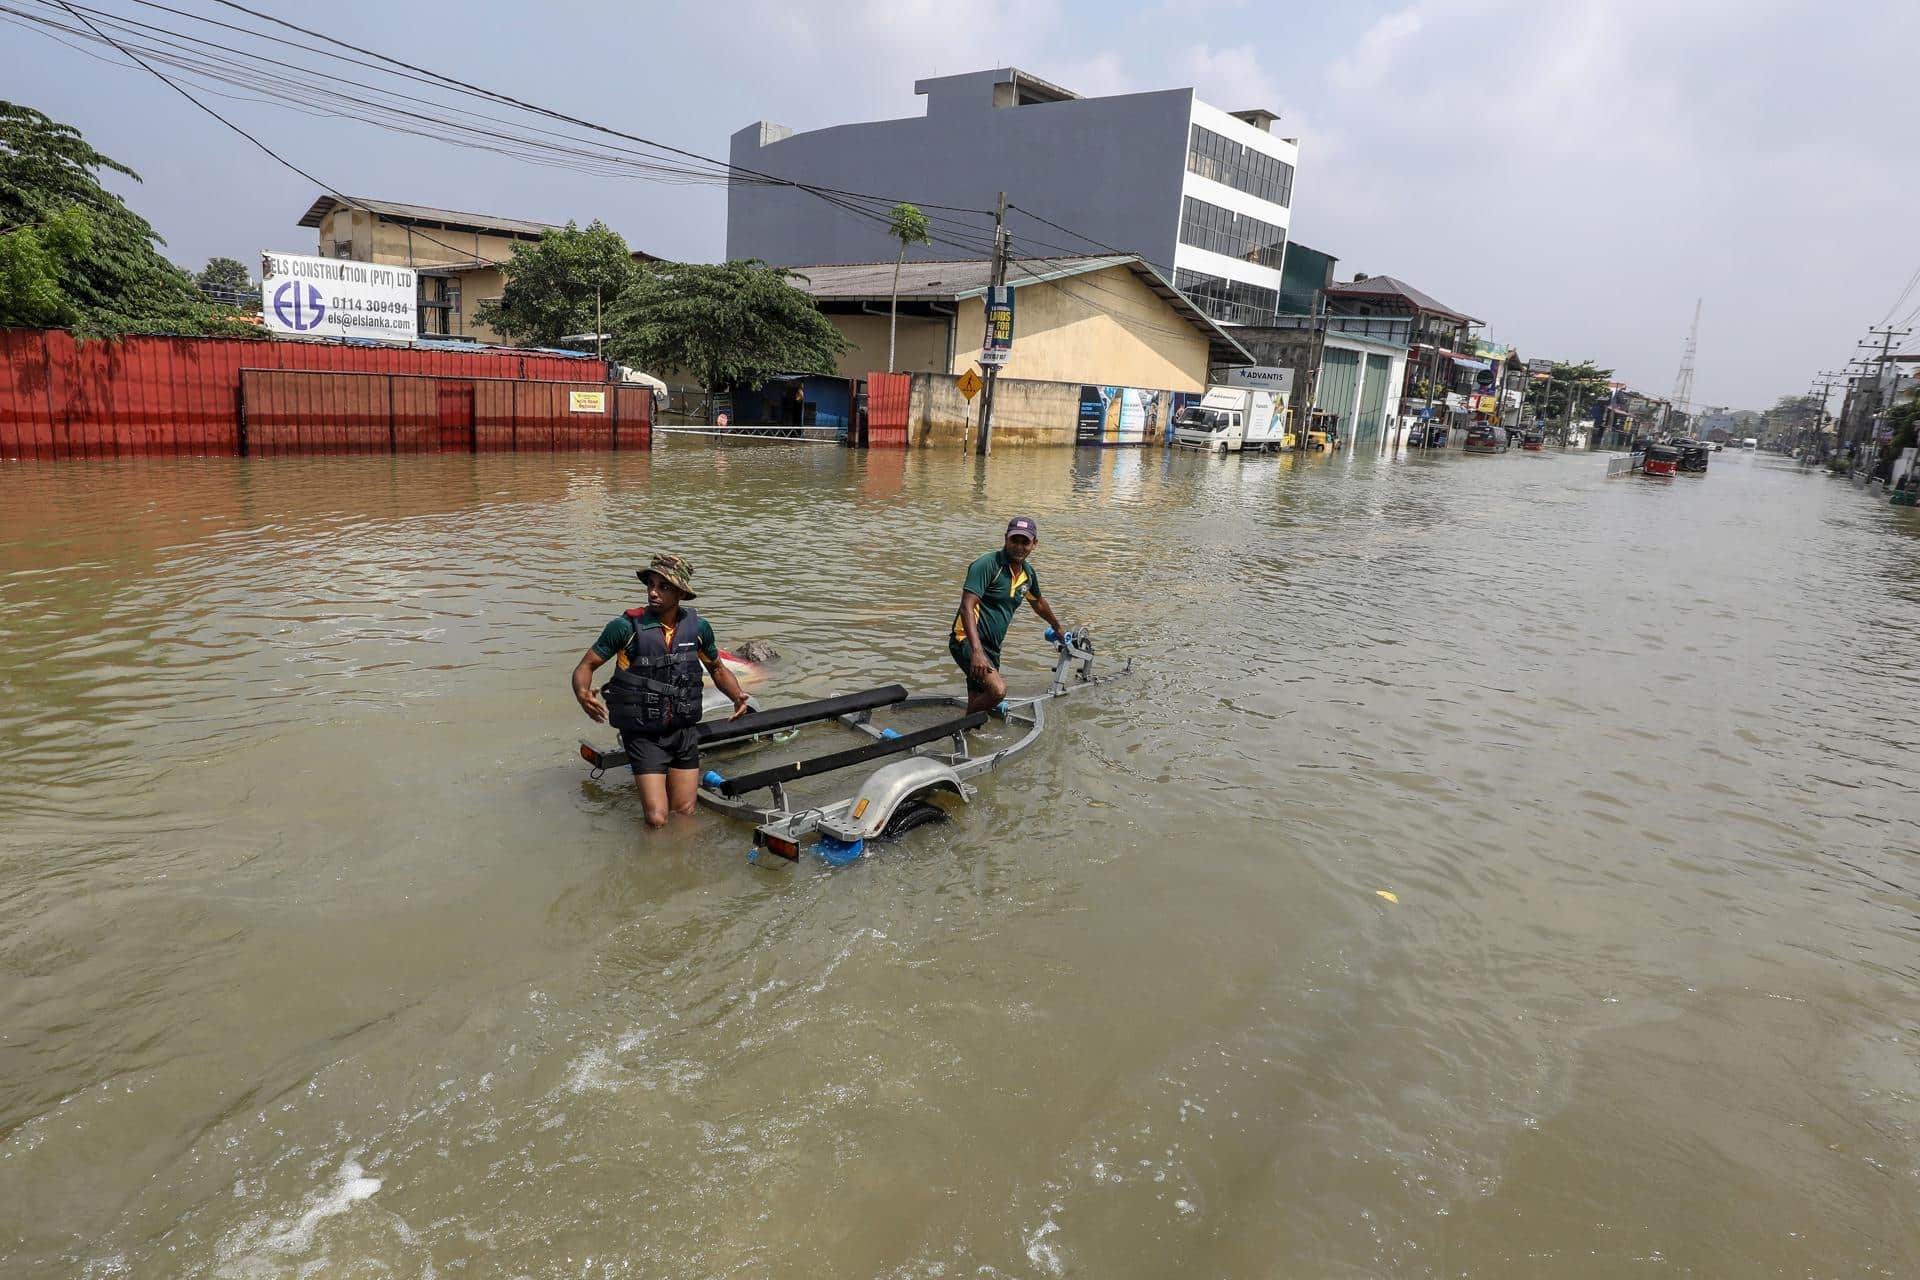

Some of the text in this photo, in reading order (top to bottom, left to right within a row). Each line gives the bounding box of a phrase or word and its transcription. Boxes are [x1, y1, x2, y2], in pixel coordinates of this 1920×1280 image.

[270, 258, 289, 276] ELS
[370, 269, 394, 289] (PVT)
[397, 273, 412, 288] LTD
[274, 281, 325, 330] ELS
[333, 297, 408, 314] 0114 309494
[328, 313, 411, 330] els@elslanka.com
[996, 321, 1010, 331] FOR
[994, 331, 1009, 339] SALE
[1247, 371, 1283, 381] ADVANTIS
